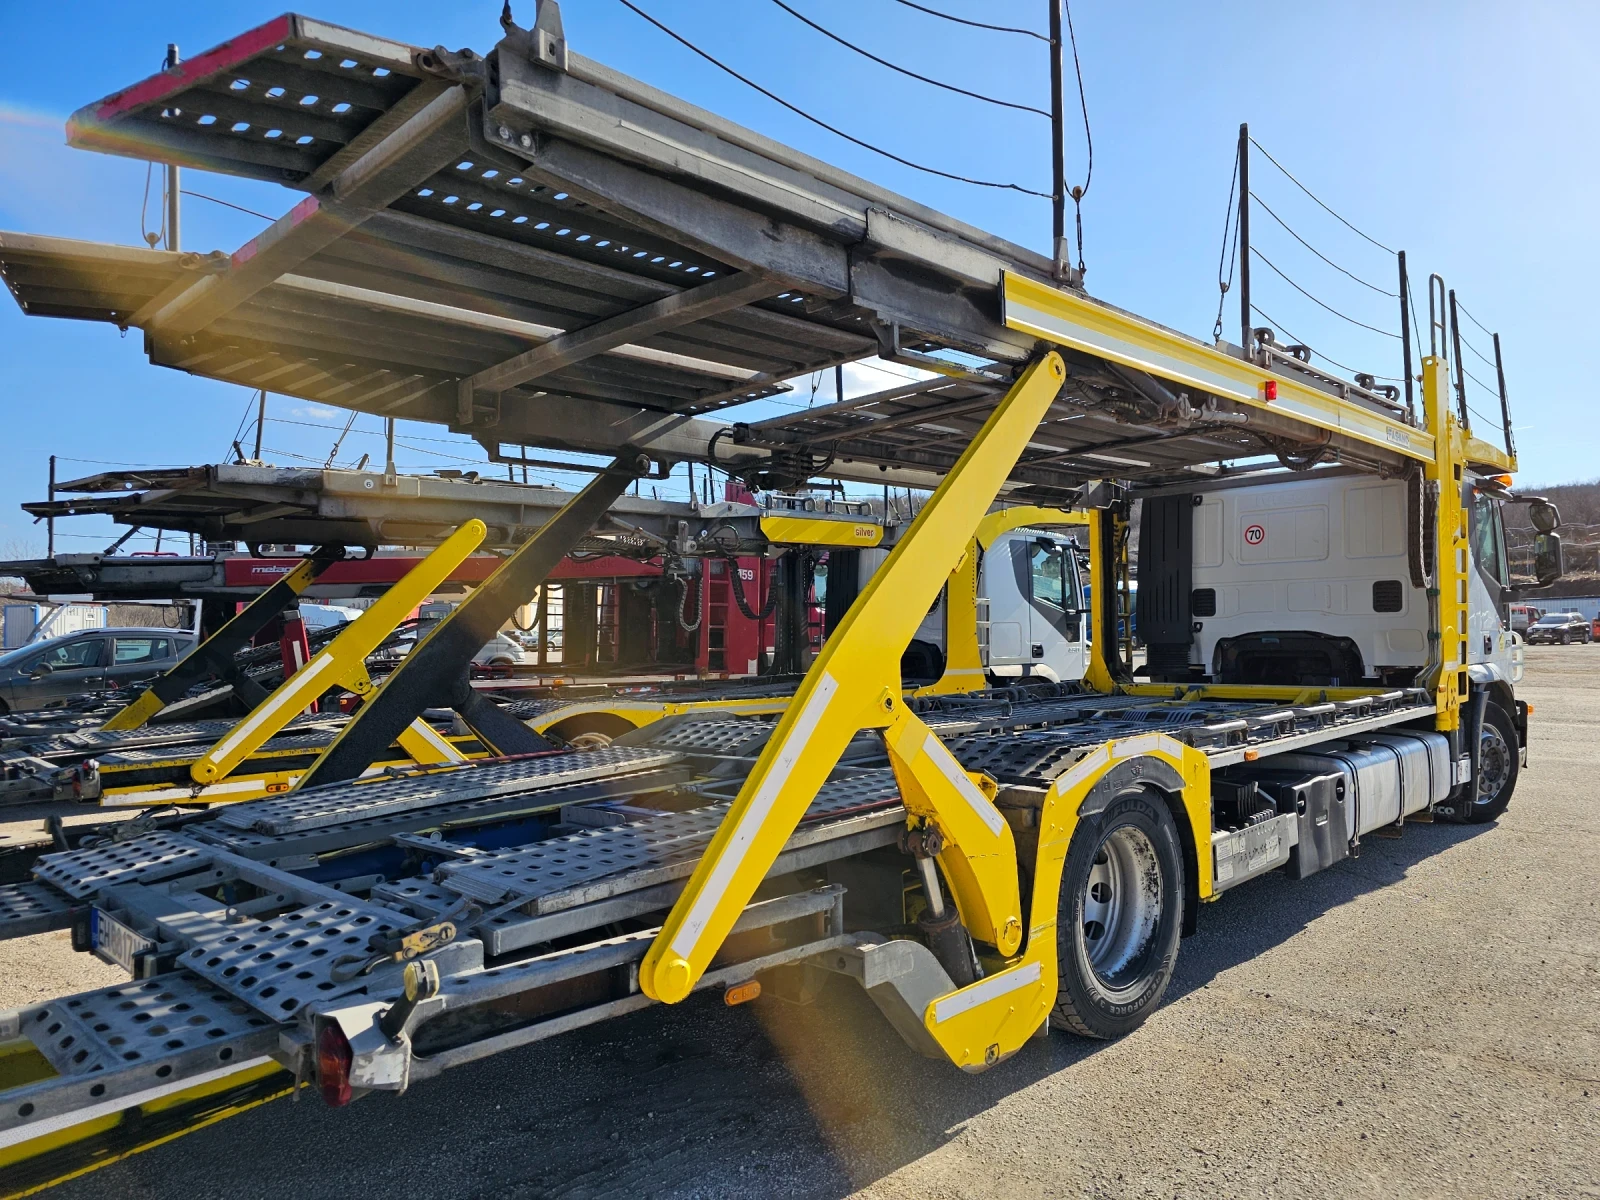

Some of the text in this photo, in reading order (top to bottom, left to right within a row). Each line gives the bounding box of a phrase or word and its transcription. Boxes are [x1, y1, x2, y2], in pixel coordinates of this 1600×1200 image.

[855, 526, 874, 538] silver
[1249, 529, 1261, 540] 70
[252, 565, 295, 574] metag
[1114, 799, 1155, 819] FULDA
[1109, 973, 1162, 1015] REGIOFORCE
